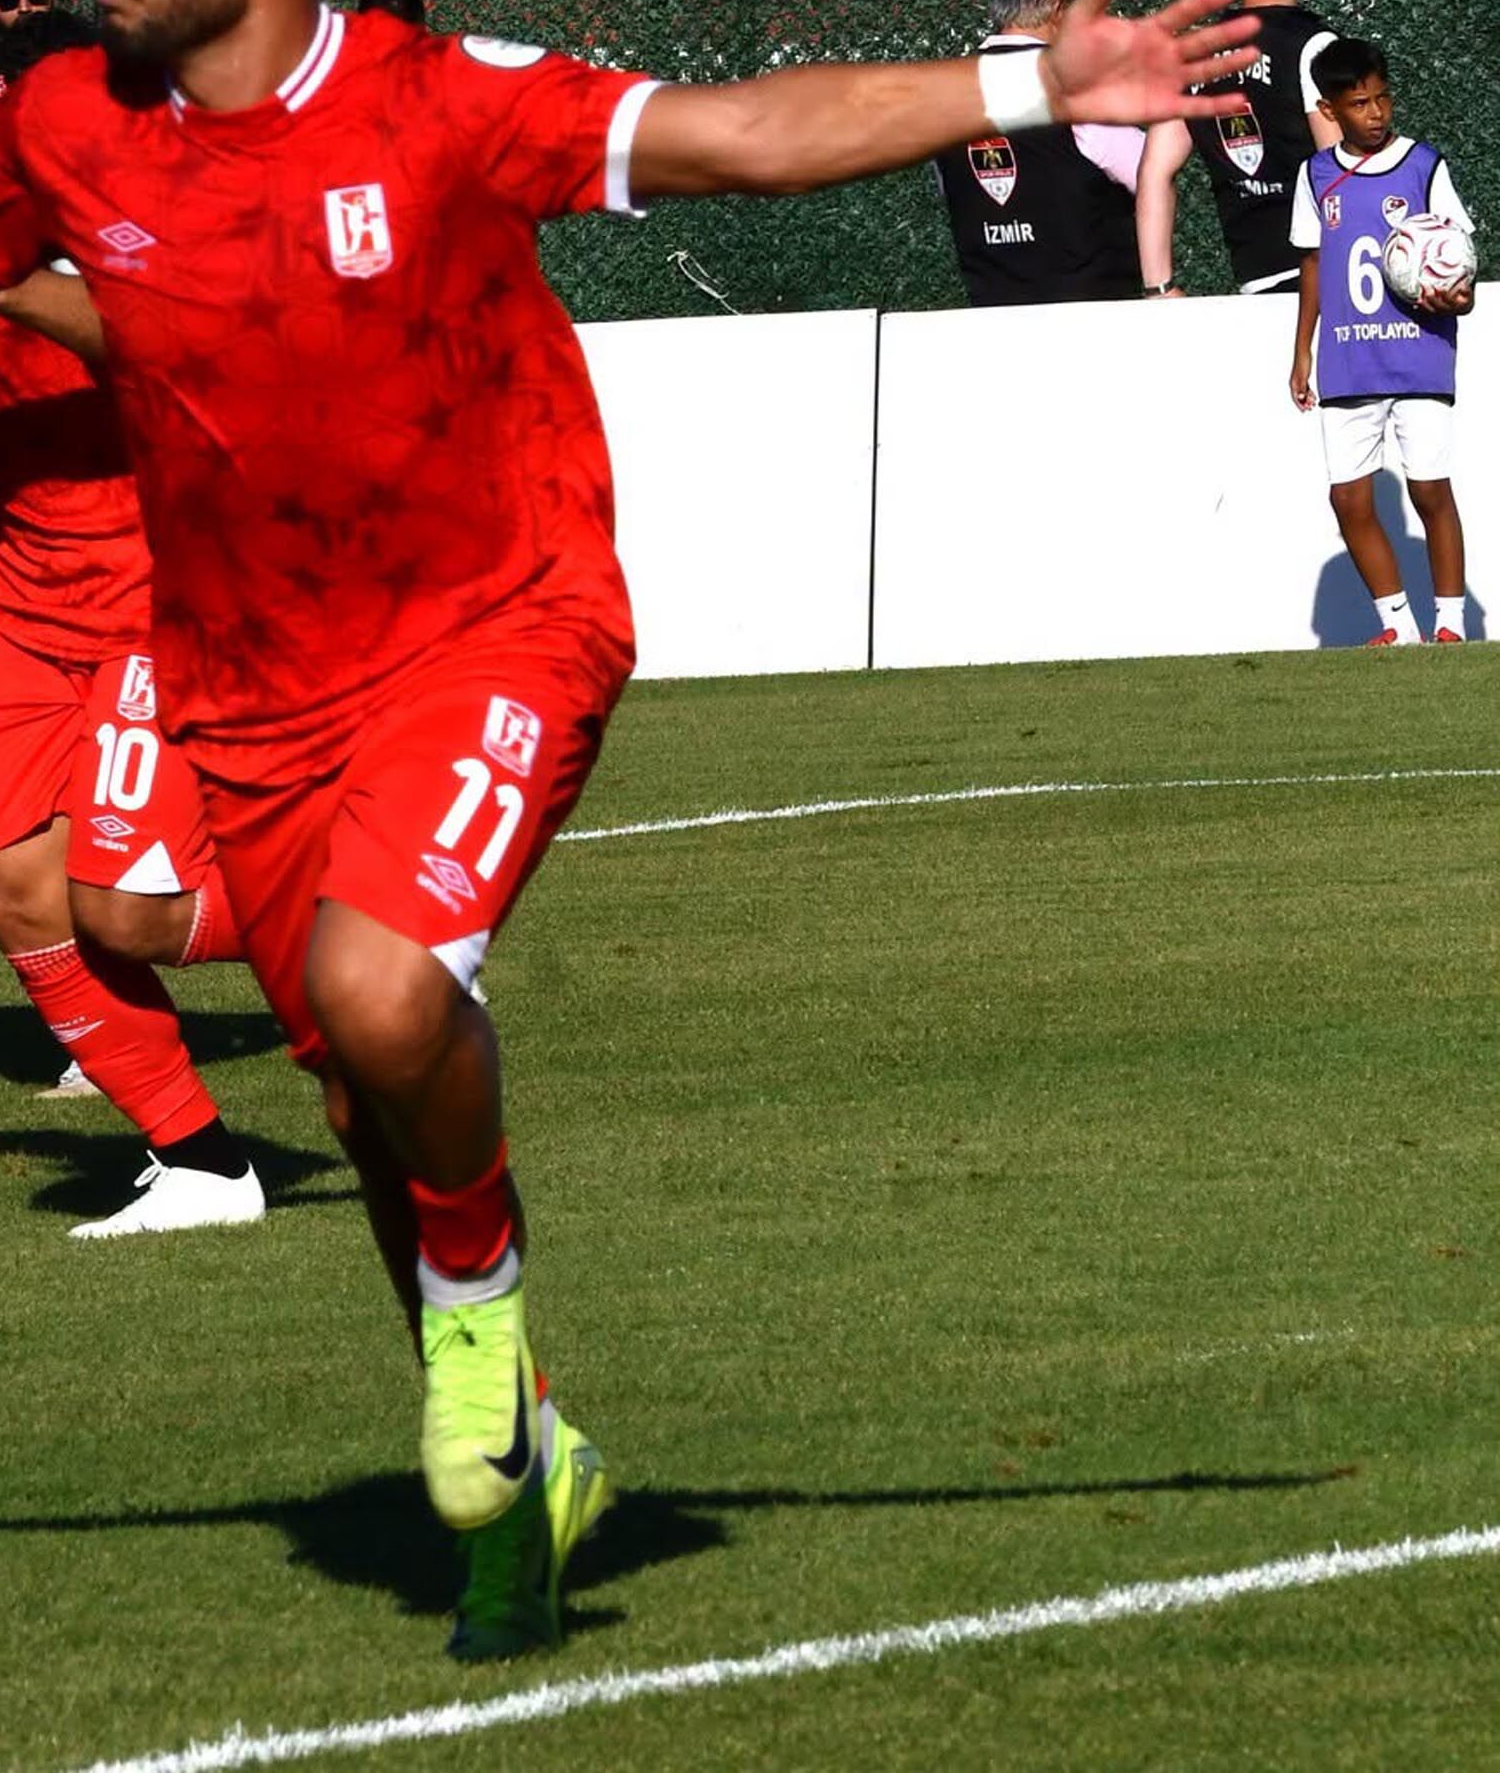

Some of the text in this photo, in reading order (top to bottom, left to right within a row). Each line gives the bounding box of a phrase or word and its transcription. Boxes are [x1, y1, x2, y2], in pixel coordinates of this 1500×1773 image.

[983, 218, 1036, 245] İZMİR
[1348, 235, 1385, 316] 6
[93, 723, 160, 811] 10
[433, 757, 525, 882] 11
